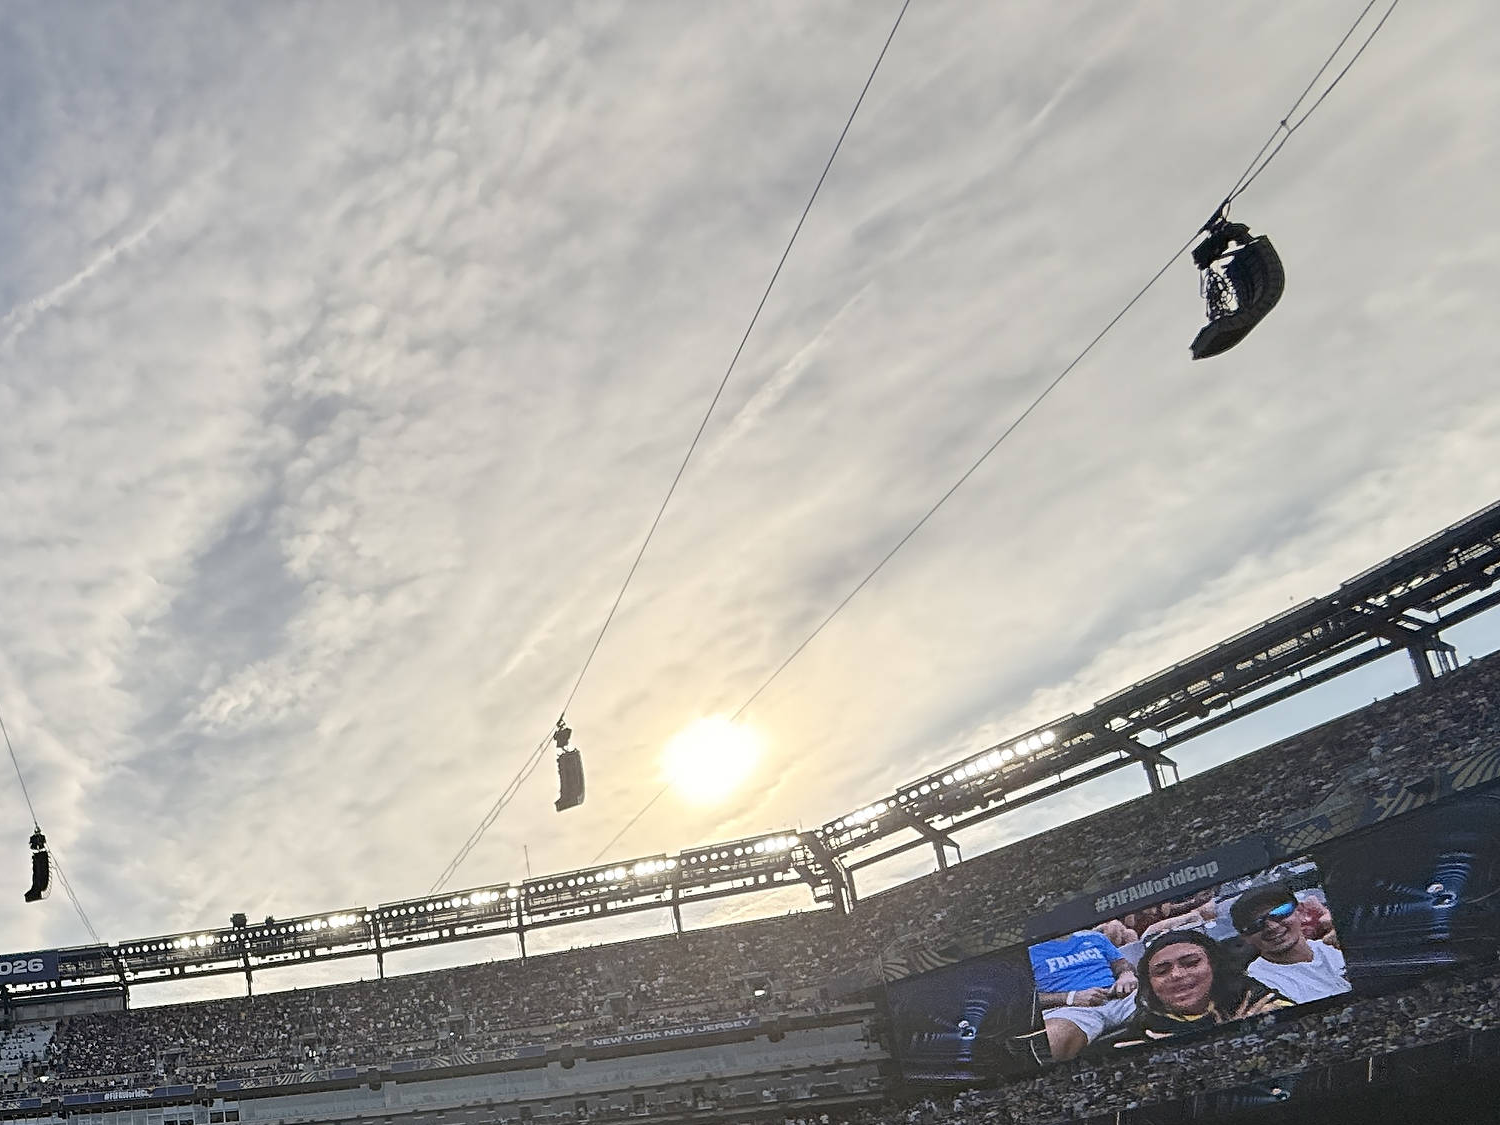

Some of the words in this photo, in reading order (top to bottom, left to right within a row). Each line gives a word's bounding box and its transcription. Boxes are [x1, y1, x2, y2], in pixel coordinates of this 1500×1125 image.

[1095, 861, 1219, 912] #FIFAWorldCup
[593, 1037, 622, 1046] NEW
[624, 1031, 661, 1042] YORK
[664, 1027, 695, 1036] NEW
[698, 1019, 752, 1032] JERSEY
